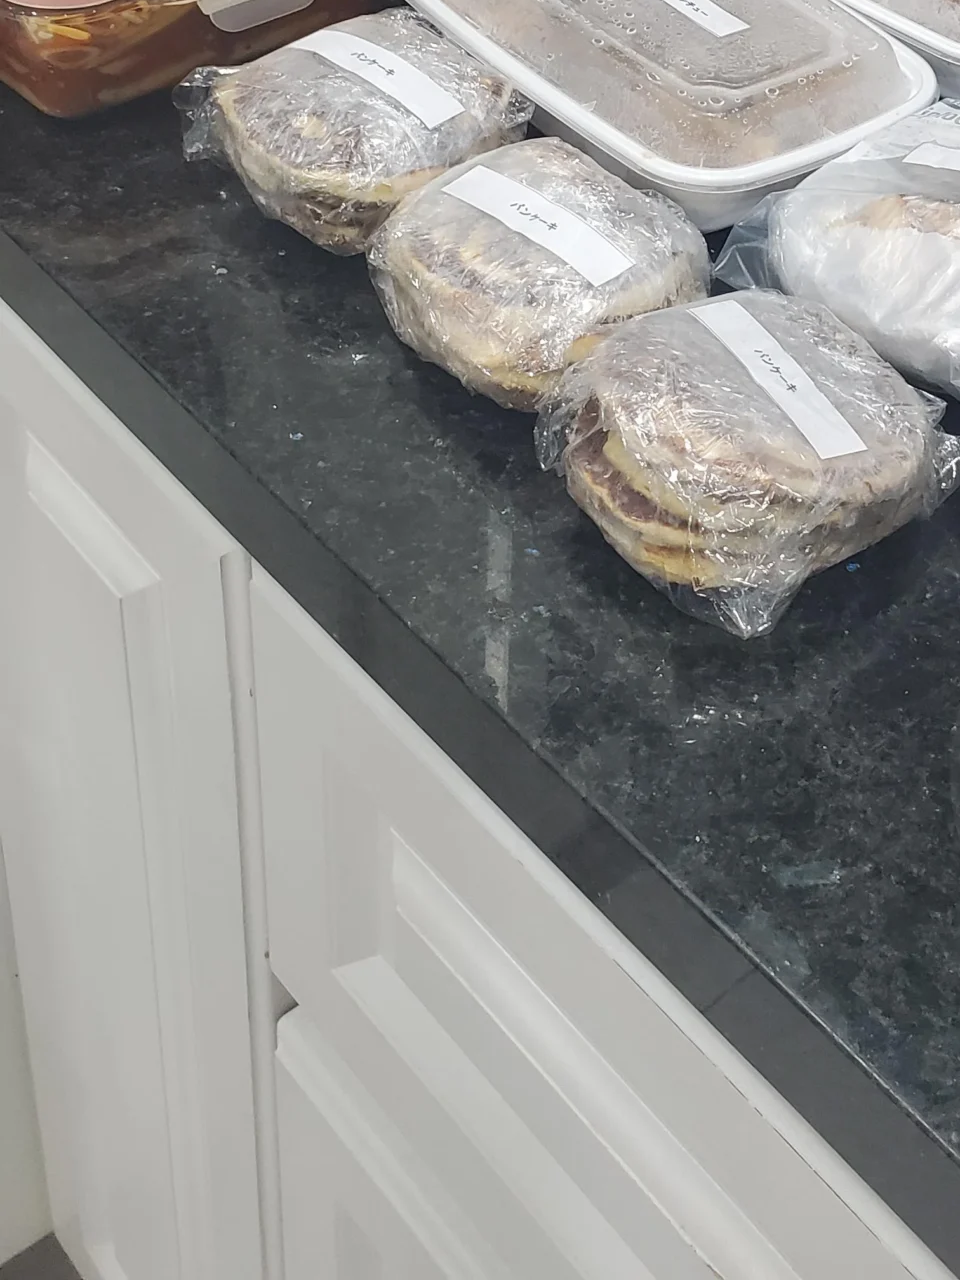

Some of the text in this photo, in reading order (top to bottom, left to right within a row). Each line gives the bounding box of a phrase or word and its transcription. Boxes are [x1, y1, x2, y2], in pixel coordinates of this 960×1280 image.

[350, 51, 396, 77] パンケーキ
[509, 201, 559, 232] パンケーキ
[753, 348, 798, 393] パンケーキ
